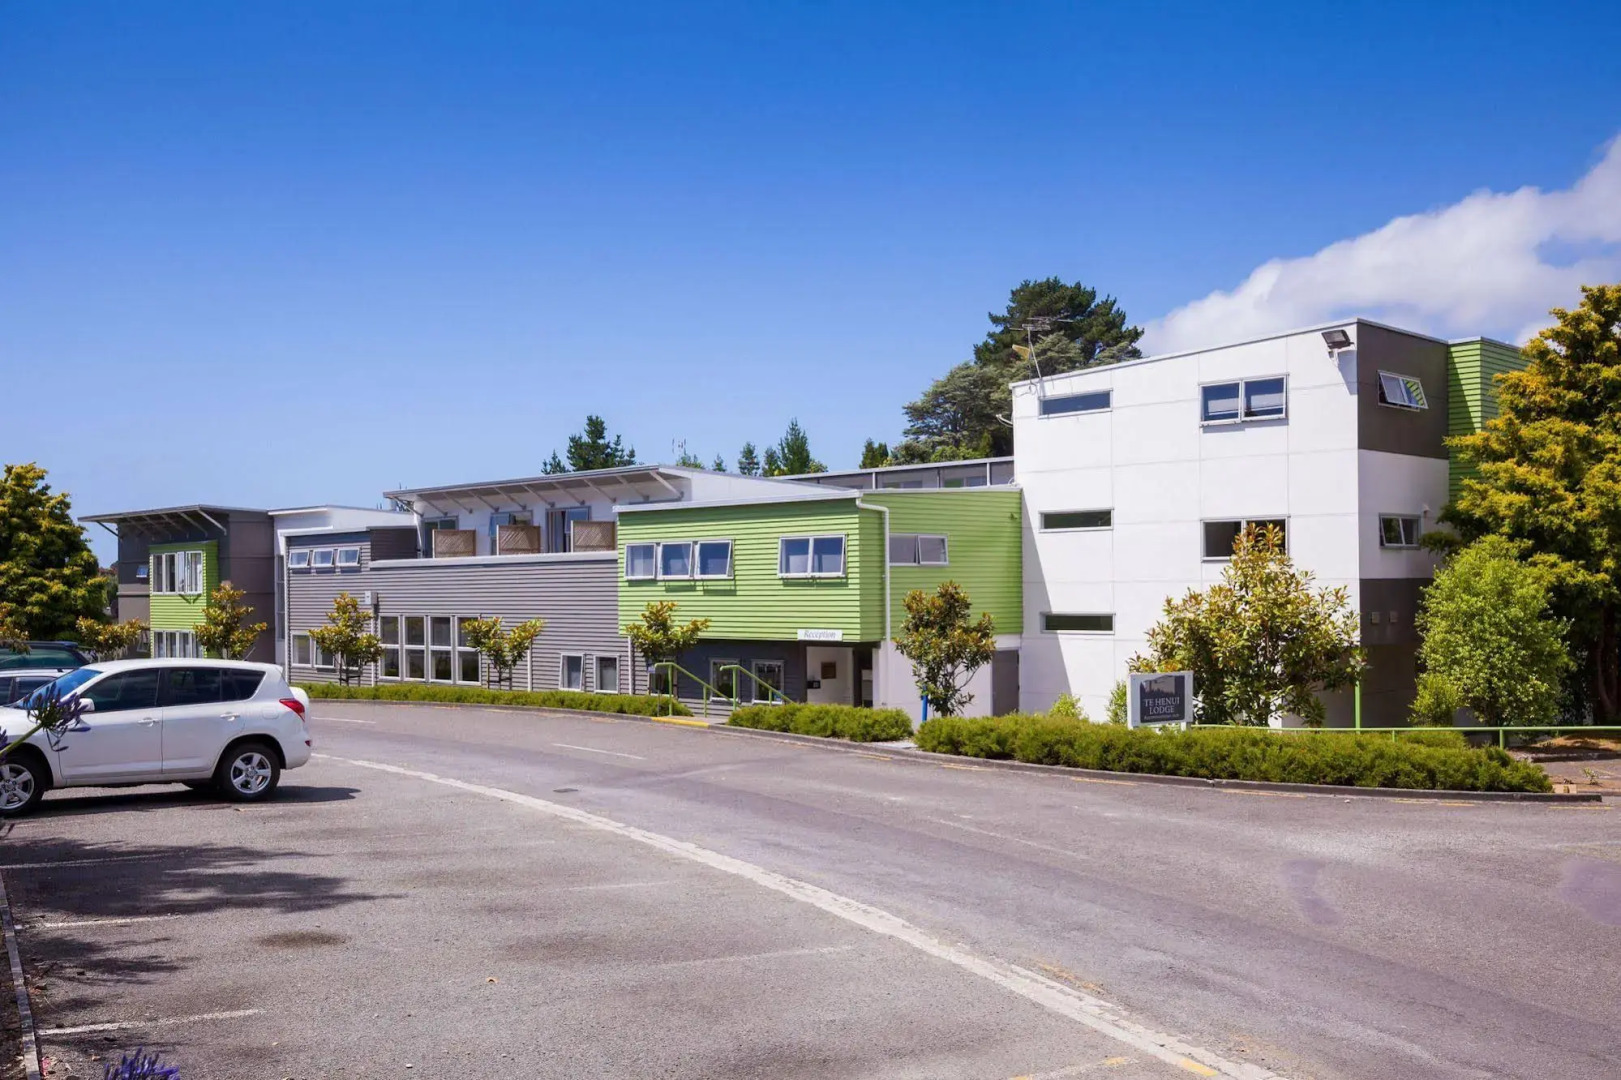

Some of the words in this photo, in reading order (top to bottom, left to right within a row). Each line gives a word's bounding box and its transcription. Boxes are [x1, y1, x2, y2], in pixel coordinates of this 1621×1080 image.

[803, 629, 837, 639] Reception
[1144, 699, 1154, 707] TE
[1155, 697, 1180, 706] HENUI
[1149, 706, 1175, 715] LODGE
